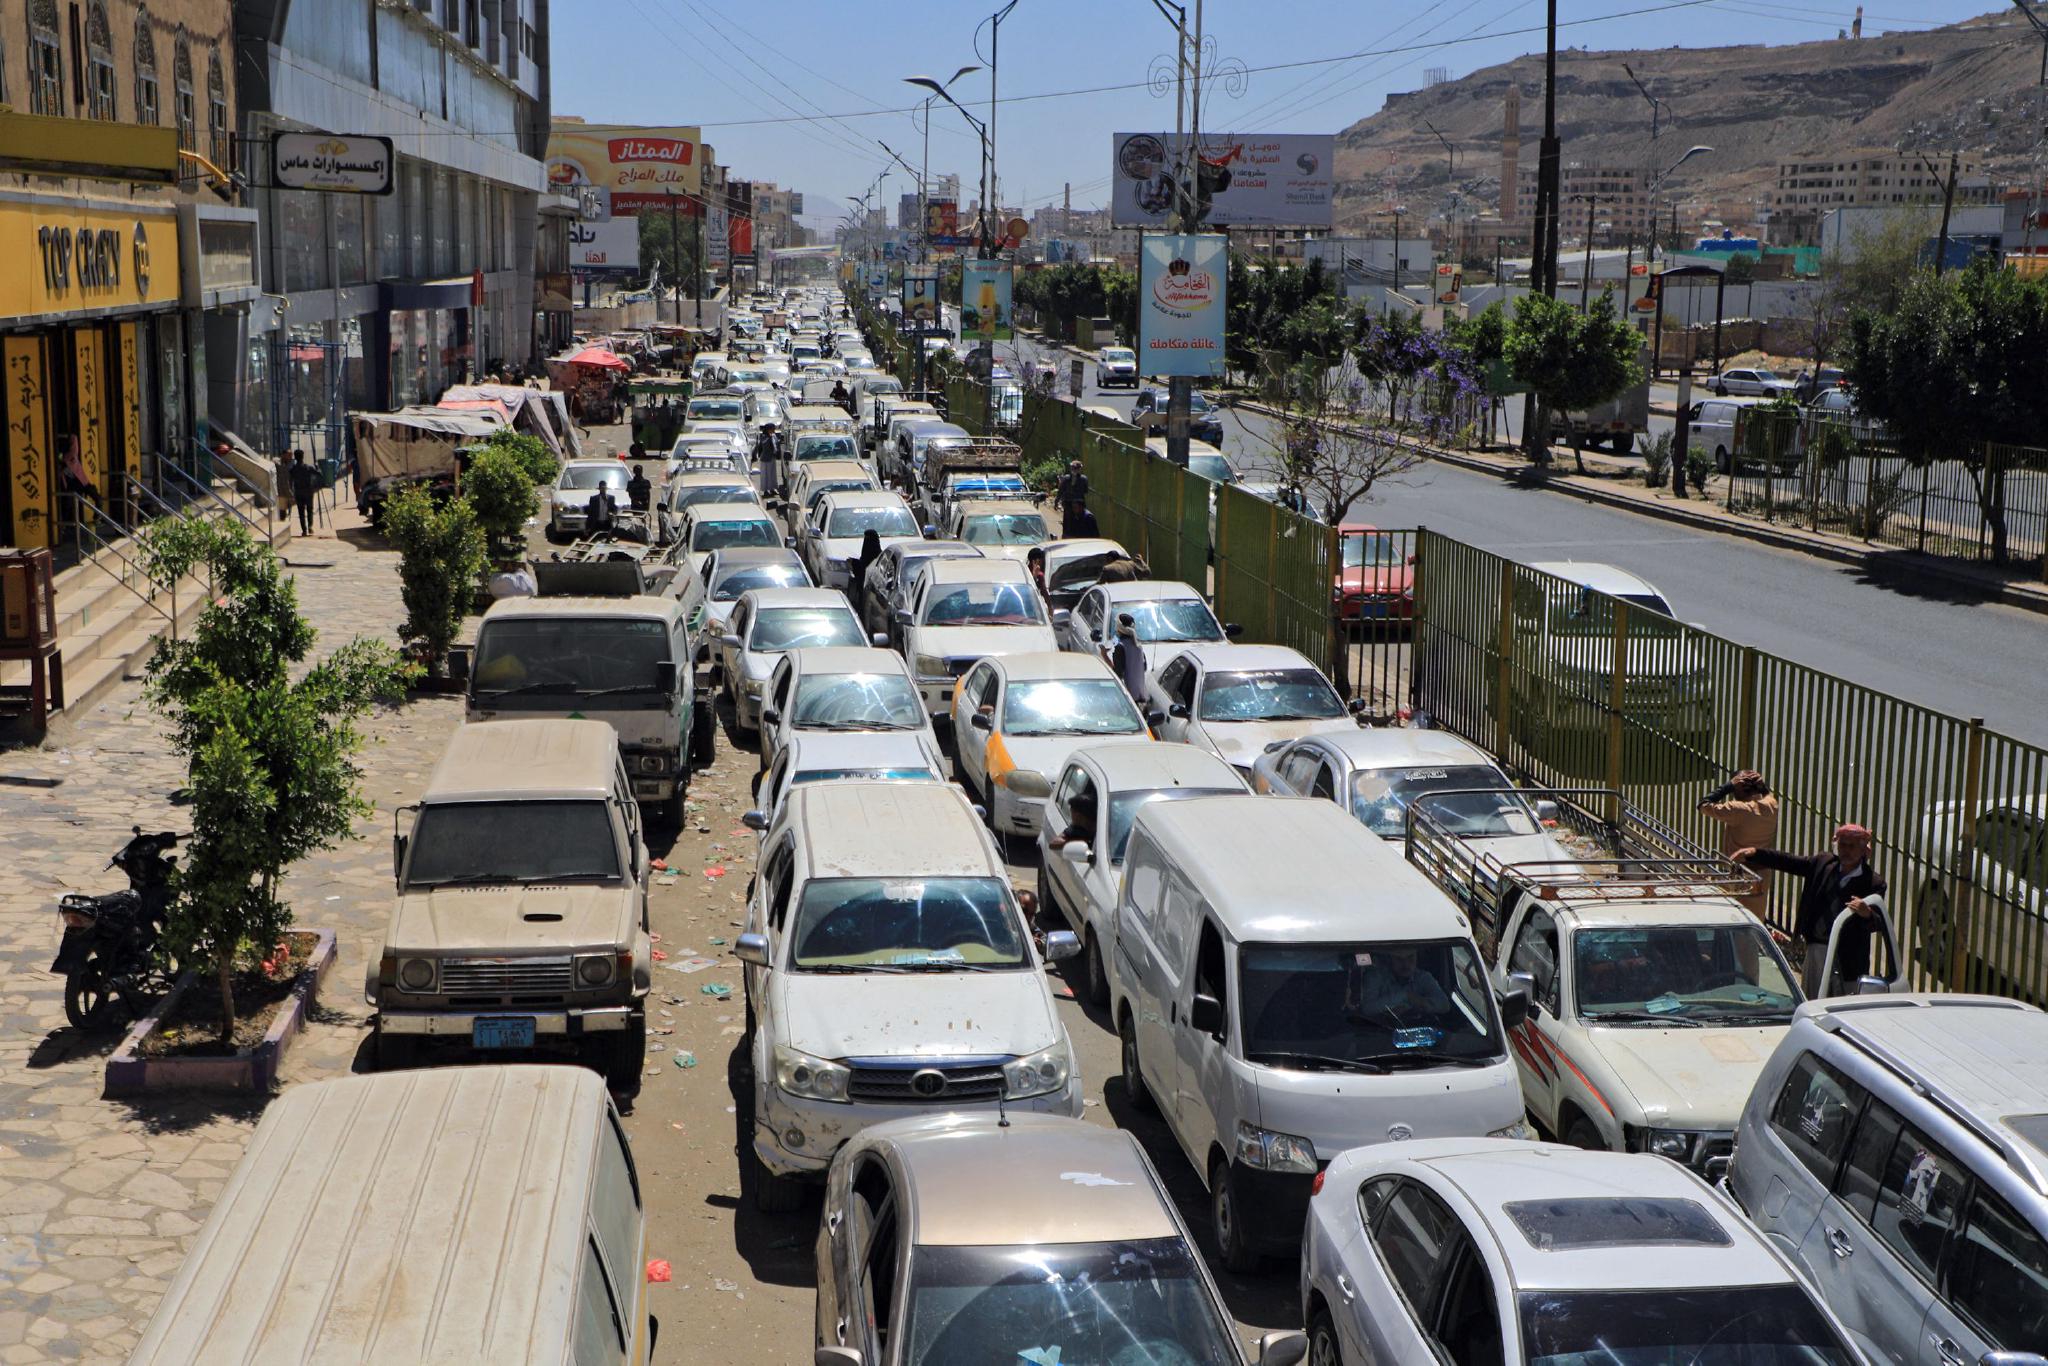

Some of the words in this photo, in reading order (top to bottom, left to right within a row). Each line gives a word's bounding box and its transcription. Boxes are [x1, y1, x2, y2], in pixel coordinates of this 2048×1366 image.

[618, 141, 684, 161] الممتاز
[280, 155, 310, 172] ماس
[312, 156, 385, 181] إكسسوارات
[617, 167, 656, 185] المزاج
[655, 170, 685, 184] ملك
[38, 225, 72, 290] TOP
[76, 226, 120, 289] CRAZY
[1150, 338, 1188, 349] متكاملة
